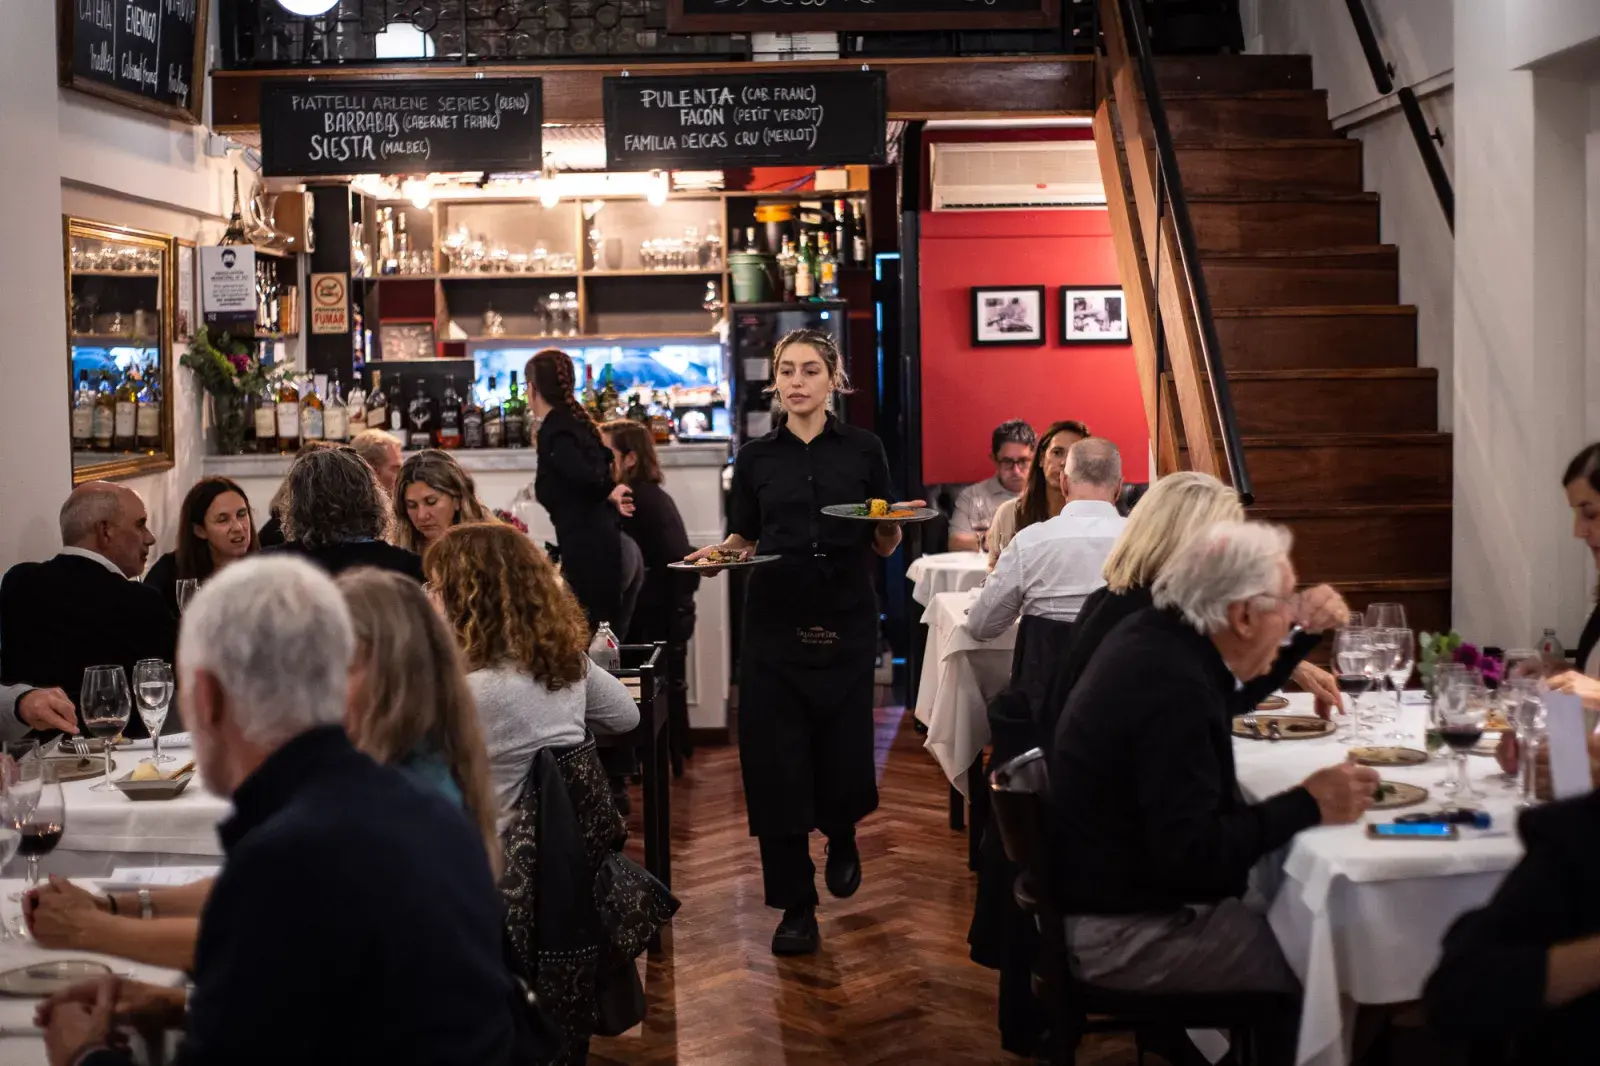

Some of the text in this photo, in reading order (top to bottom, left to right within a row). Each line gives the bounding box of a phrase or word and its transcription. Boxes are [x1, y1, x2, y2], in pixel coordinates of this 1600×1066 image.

[292, 95, 366, 110] PIATTELLI
[373, 96, 428, 110] ARLENE
[438, 96, 490, 112] SERIES
[640, 87, 735, 109] PULENTA
[774, 84, 816, 103] FRANC)
[324, 111, 501, 137] BARRABAS (CABERNET FRANC)
[774, 104, 824, 126] VERDOT)
[308, 135, 430, 161] SIESTA (MALBEC)
[624, 124, 817, 151] FAMILIA DEICAS CRU (MERLOT)
[315, 313, 345, 325] FUMAR
